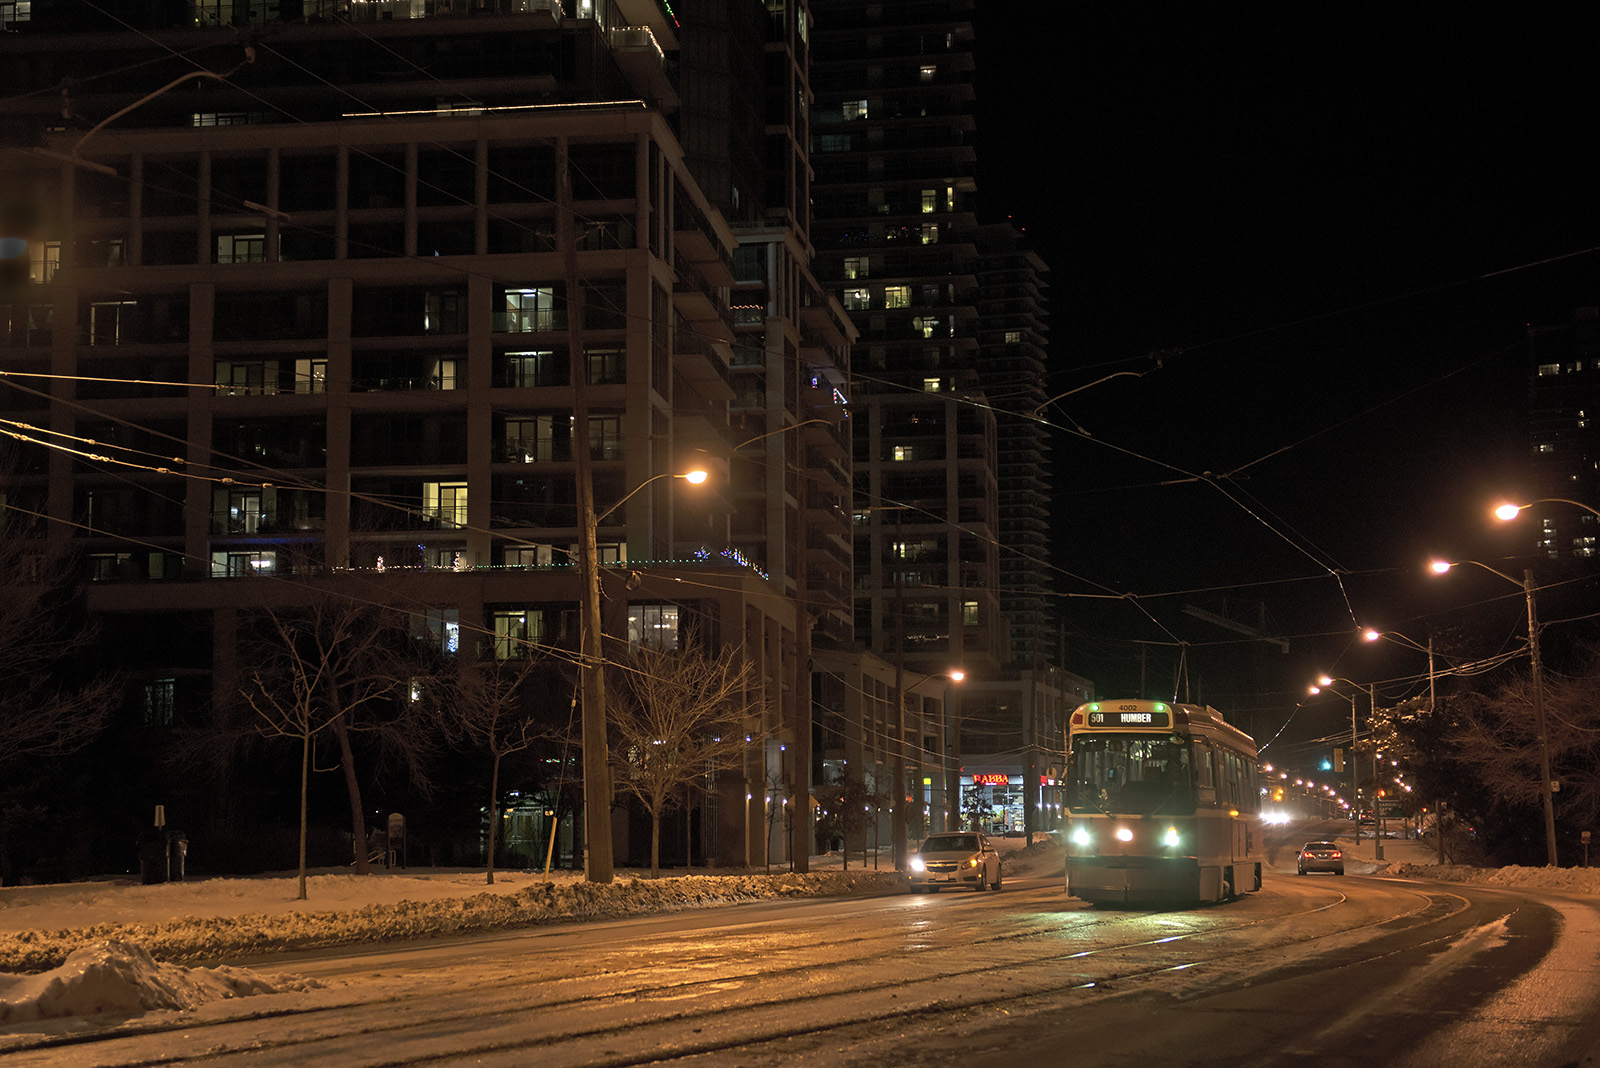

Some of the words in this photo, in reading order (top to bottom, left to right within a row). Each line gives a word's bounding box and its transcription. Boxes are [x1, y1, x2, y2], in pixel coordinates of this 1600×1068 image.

[1090, 713, 1104, 723] 501
[1120, 713, 1152, 723] HUMBER
[973, 774, 1009, 784] RABBA
